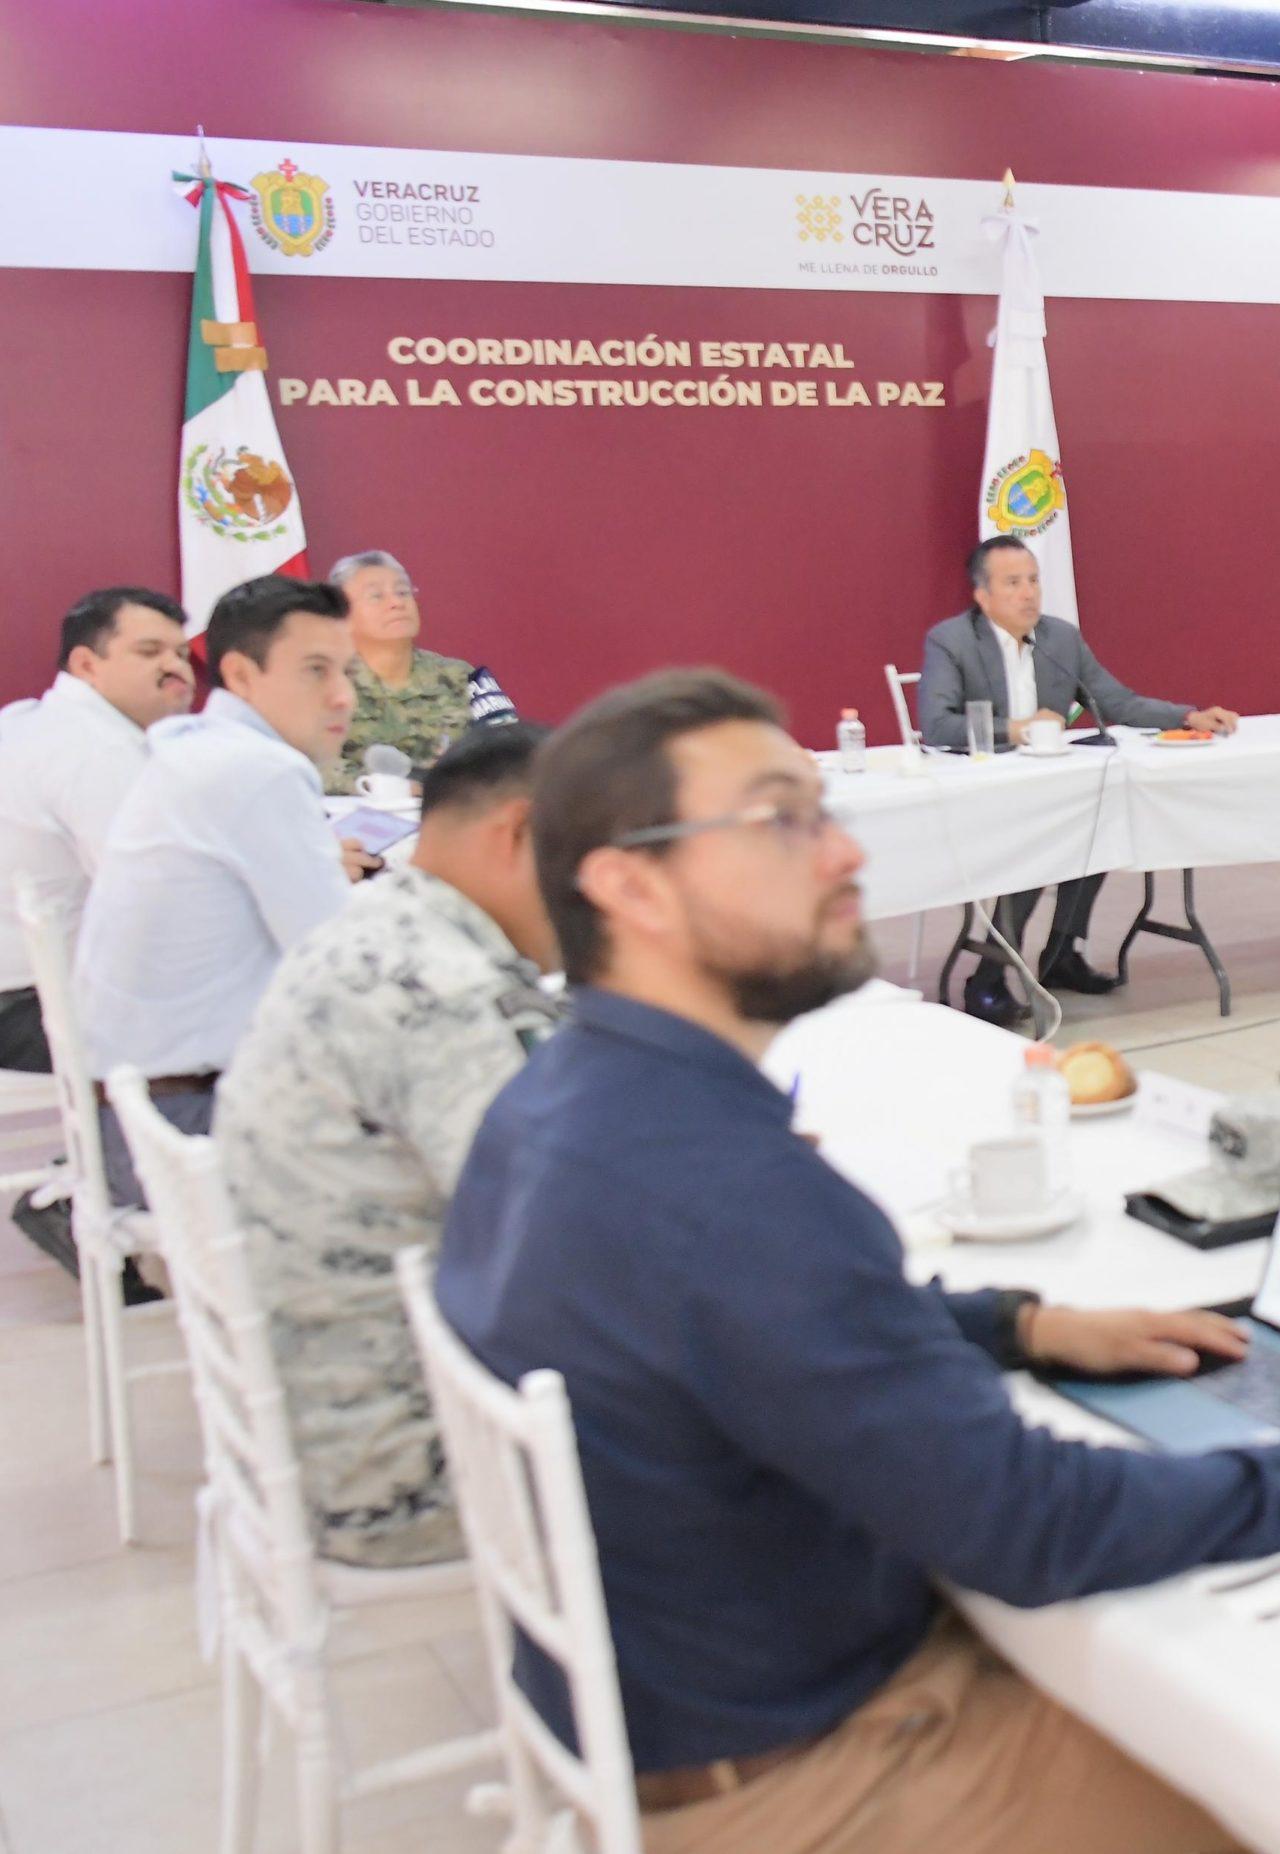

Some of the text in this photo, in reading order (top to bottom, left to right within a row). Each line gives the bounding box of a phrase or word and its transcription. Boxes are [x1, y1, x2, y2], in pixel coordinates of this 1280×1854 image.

[353, 180, 480, 203] VERACRUZ
[850, 188, 934, 222] VERA
[356, 203, 474, 225] GOBIERNO
[359, 226, 496, 248] DEL ESTADO
[853, 222, 935, 256] CRUZ
[799, 262, 938, 277] ME LLENA DE ORGULLO
[387, 333, 855, 369] COORDINACIÓN ESTATAL
[279, 374, 946, 407] PARA LA CONSTRUCCIÓN DE LA PAZ
